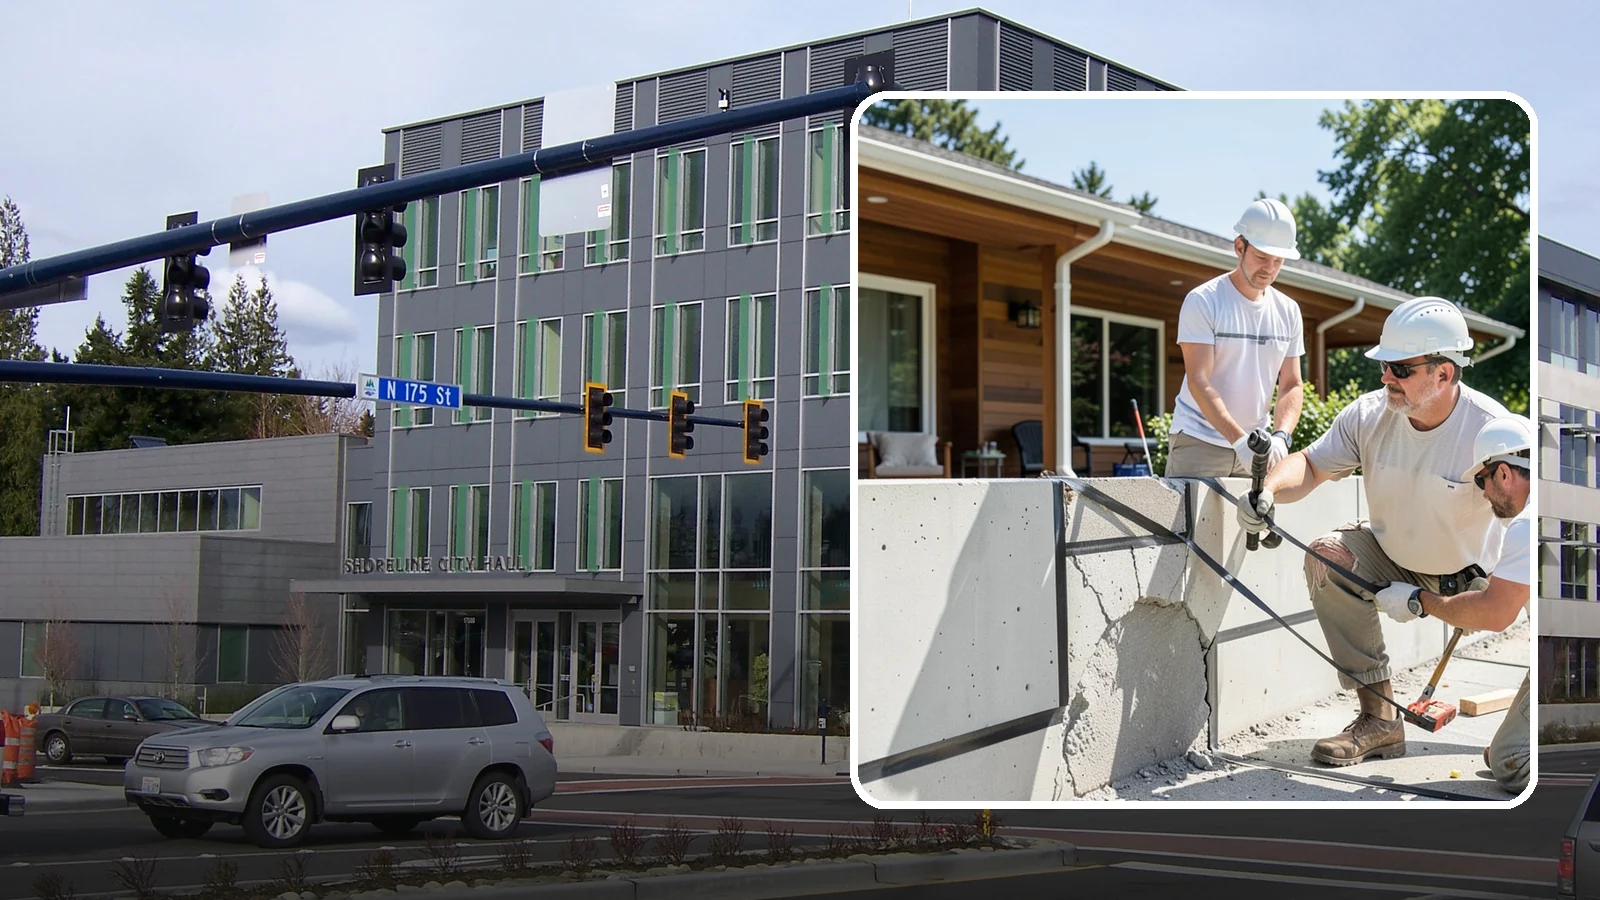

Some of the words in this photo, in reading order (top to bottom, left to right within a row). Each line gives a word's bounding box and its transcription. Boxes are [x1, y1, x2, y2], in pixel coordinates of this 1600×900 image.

[387, 380, 396, 400] N
[405, 382, 428, 403] 175
[436, 386, 452, 406] St
[344, 557, 431, 574] SHORELINE
[438, 556, 475, 573] CITY
[484, 555, 525, 572] HALL
